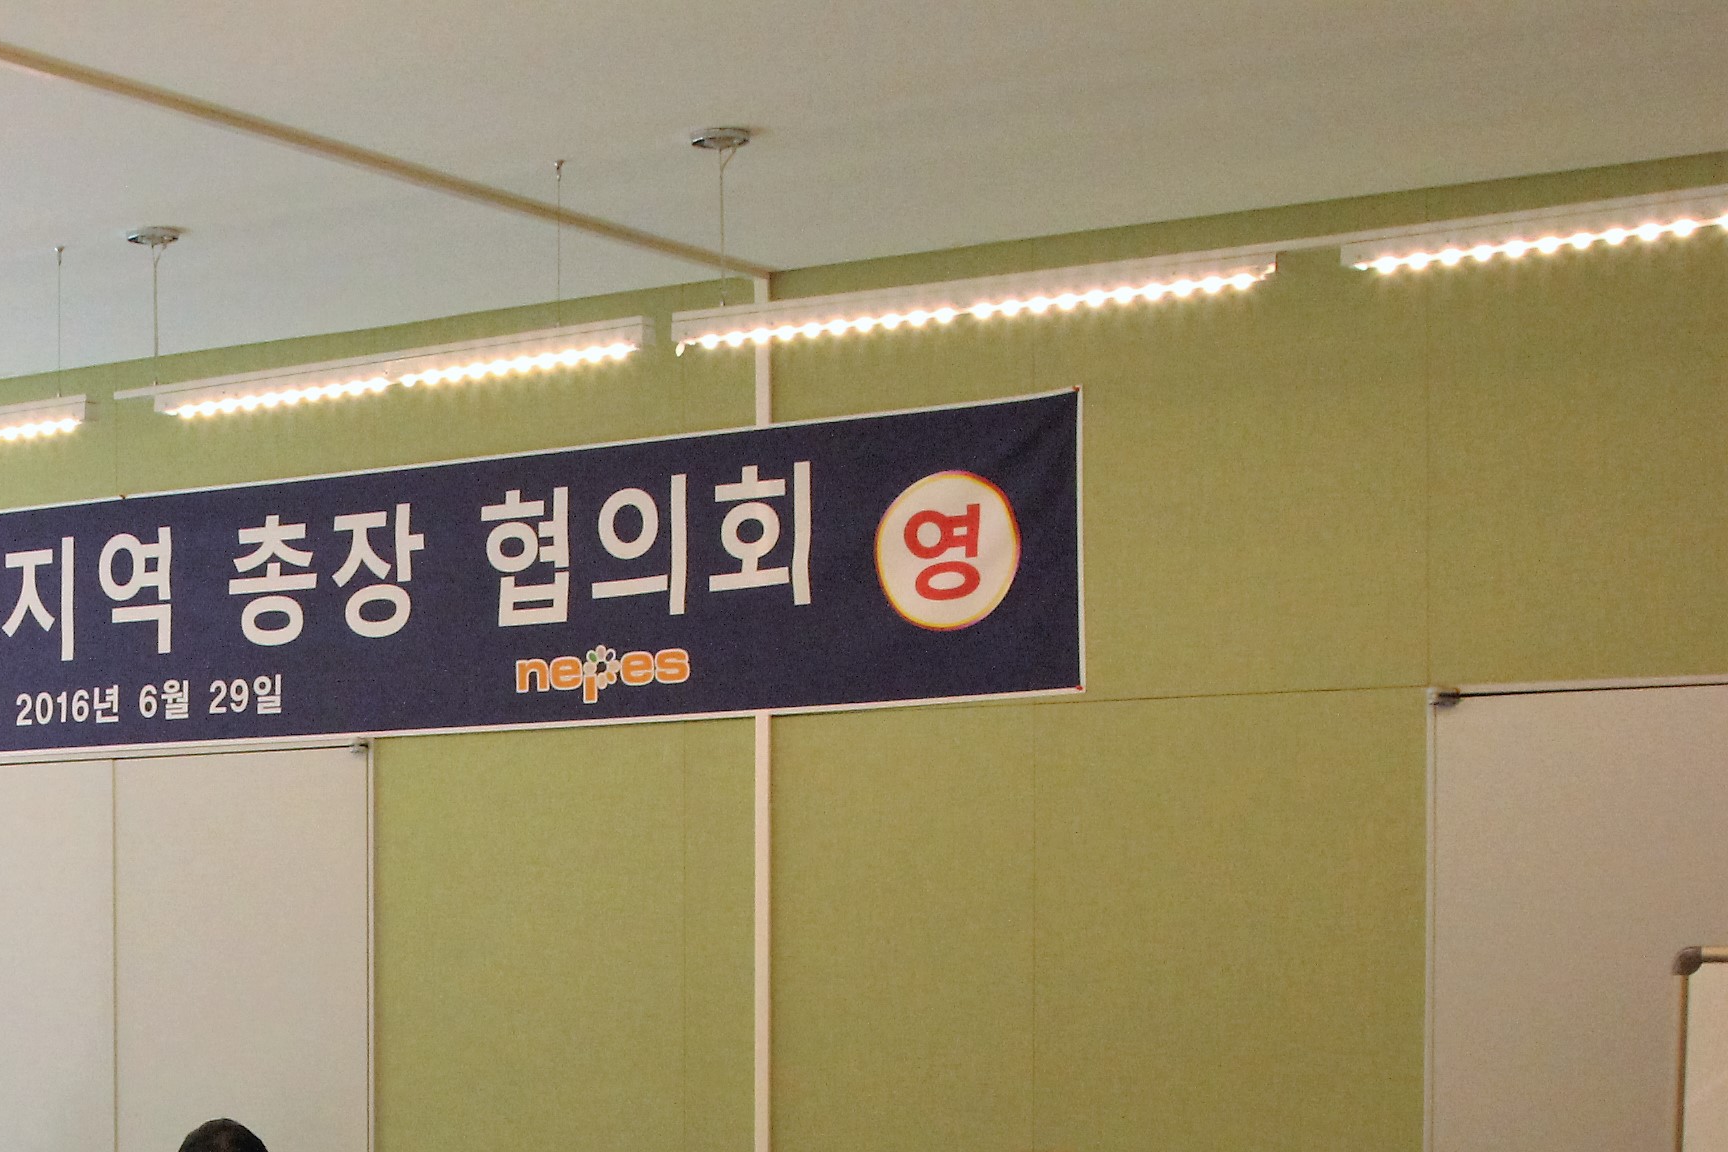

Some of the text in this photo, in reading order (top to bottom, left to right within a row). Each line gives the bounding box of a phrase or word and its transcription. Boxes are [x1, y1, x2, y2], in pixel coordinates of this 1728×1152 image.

[228, 503, 425, 646] 총장
[480, 461, 811, 627] 협의회
[903, 503, 980, 600] 영
[15, 684, 120, 726] 2016년
[139, 679, 190, 721] 6월
[209, 673, 284, 716] 29일
[516, 645, 691, 704] nepes
